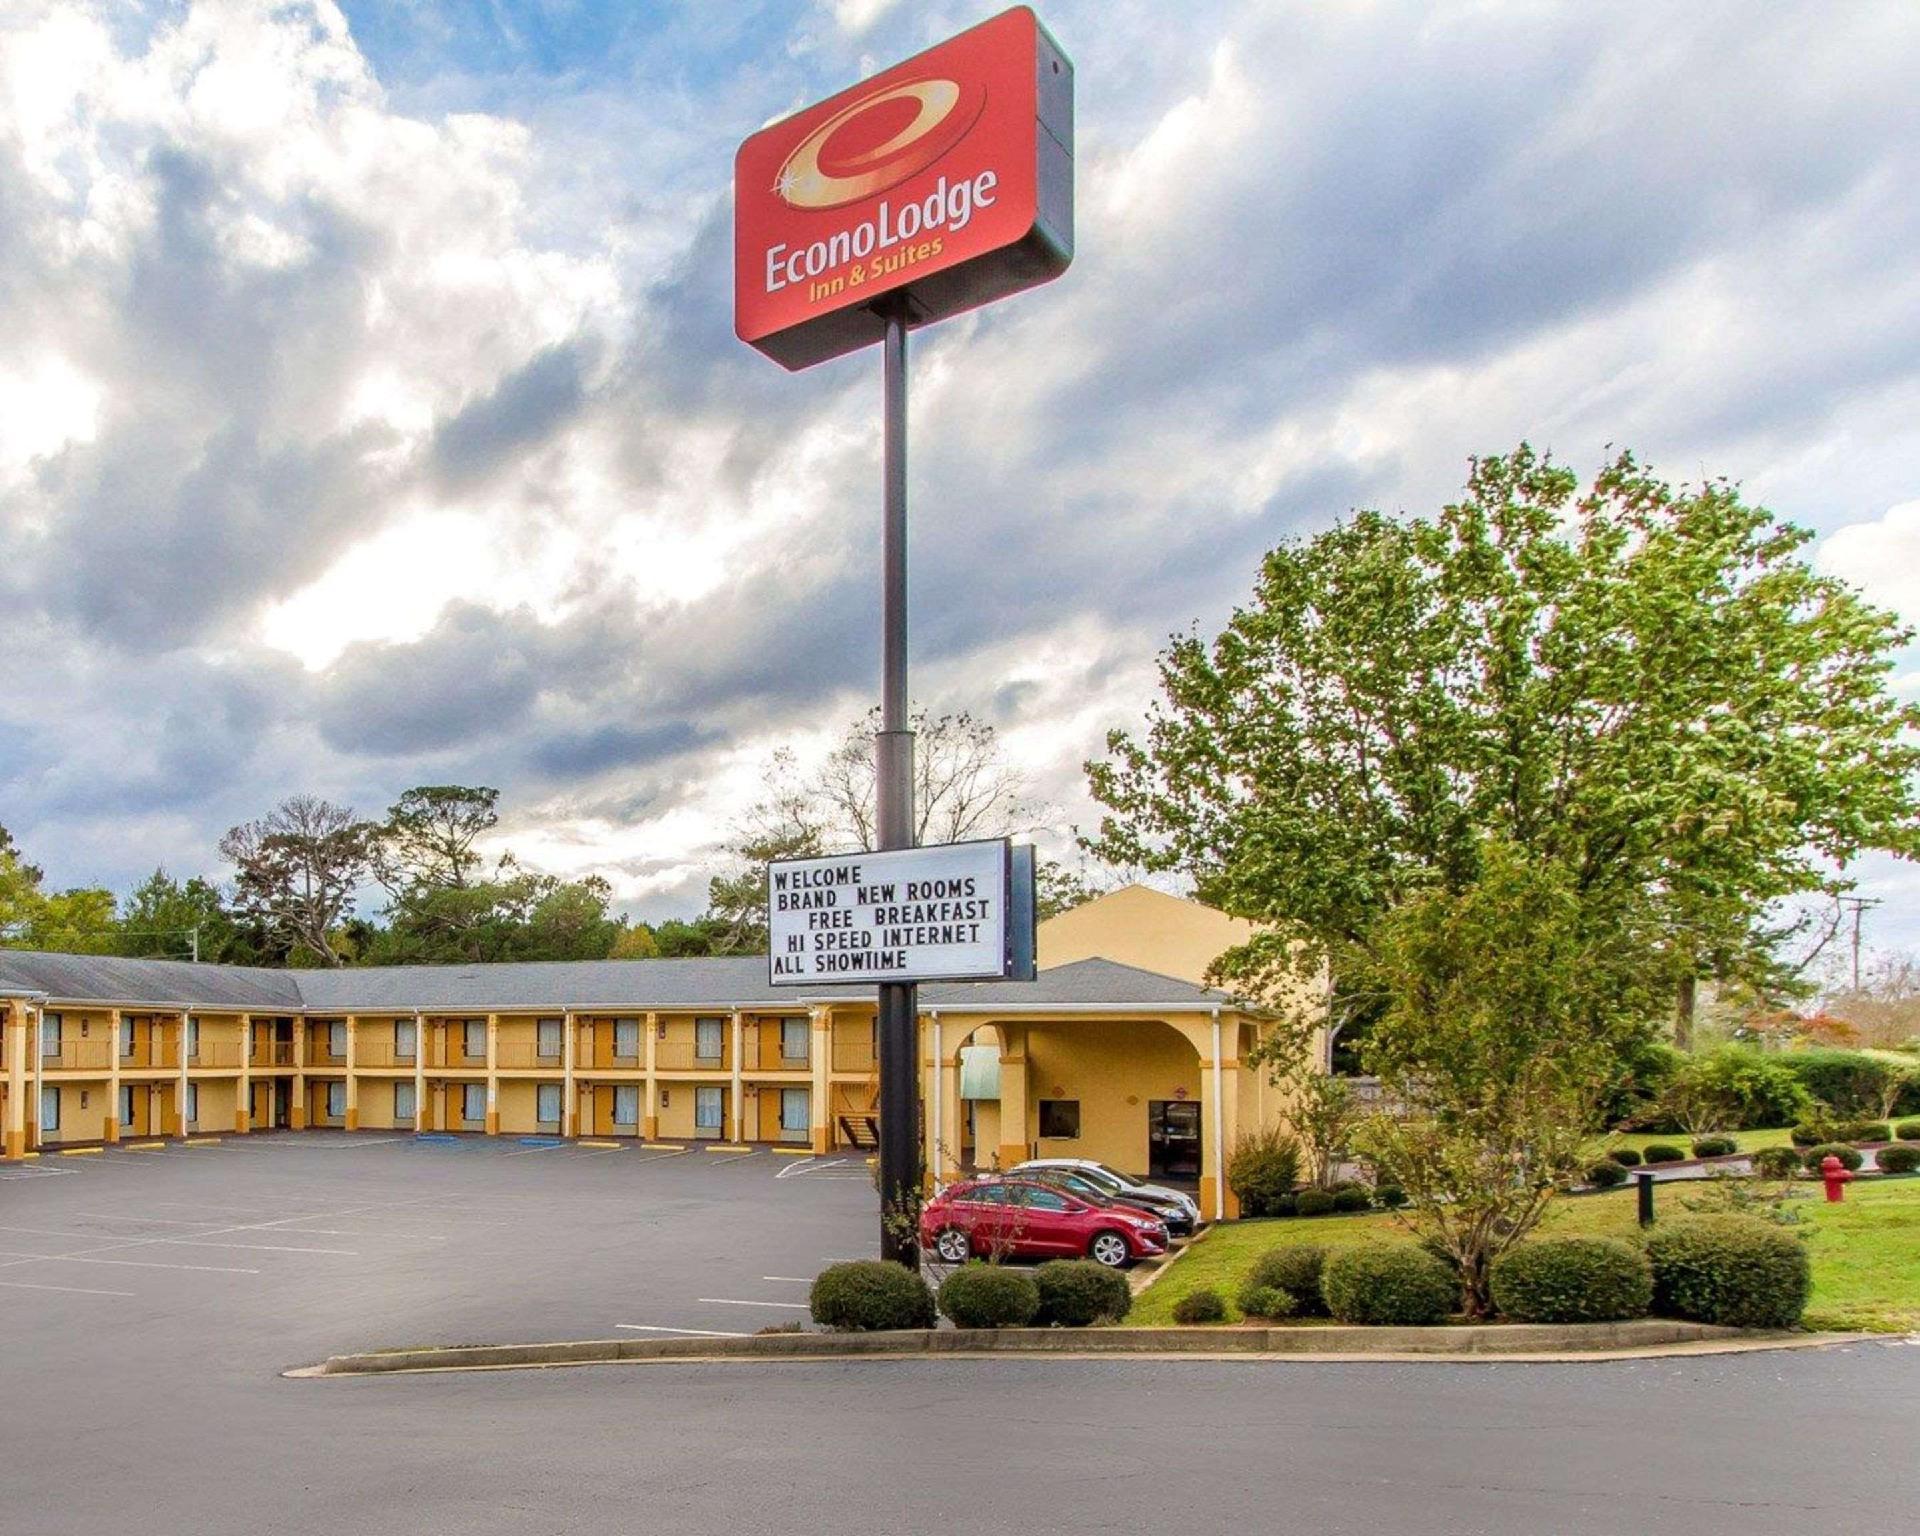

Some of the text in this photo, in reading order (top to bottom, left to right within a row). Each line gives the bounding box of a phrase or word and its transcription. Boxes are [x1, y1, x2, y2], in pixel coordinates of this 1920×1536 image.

[766, 170, 997, 293] EconoLodge
[810, 236, 943, 303] Inn & Suites
[774, 866, 861, 890] WELCOME
[778, 878, 975, 911] BRAND NEW ROOMS
[809, 900, 989, 930] FREE BREAKFAST
[788, 924, 980, 952] HI SPEED INTERNET
[774, 950, 906, 974] ALL SHOWTIME
